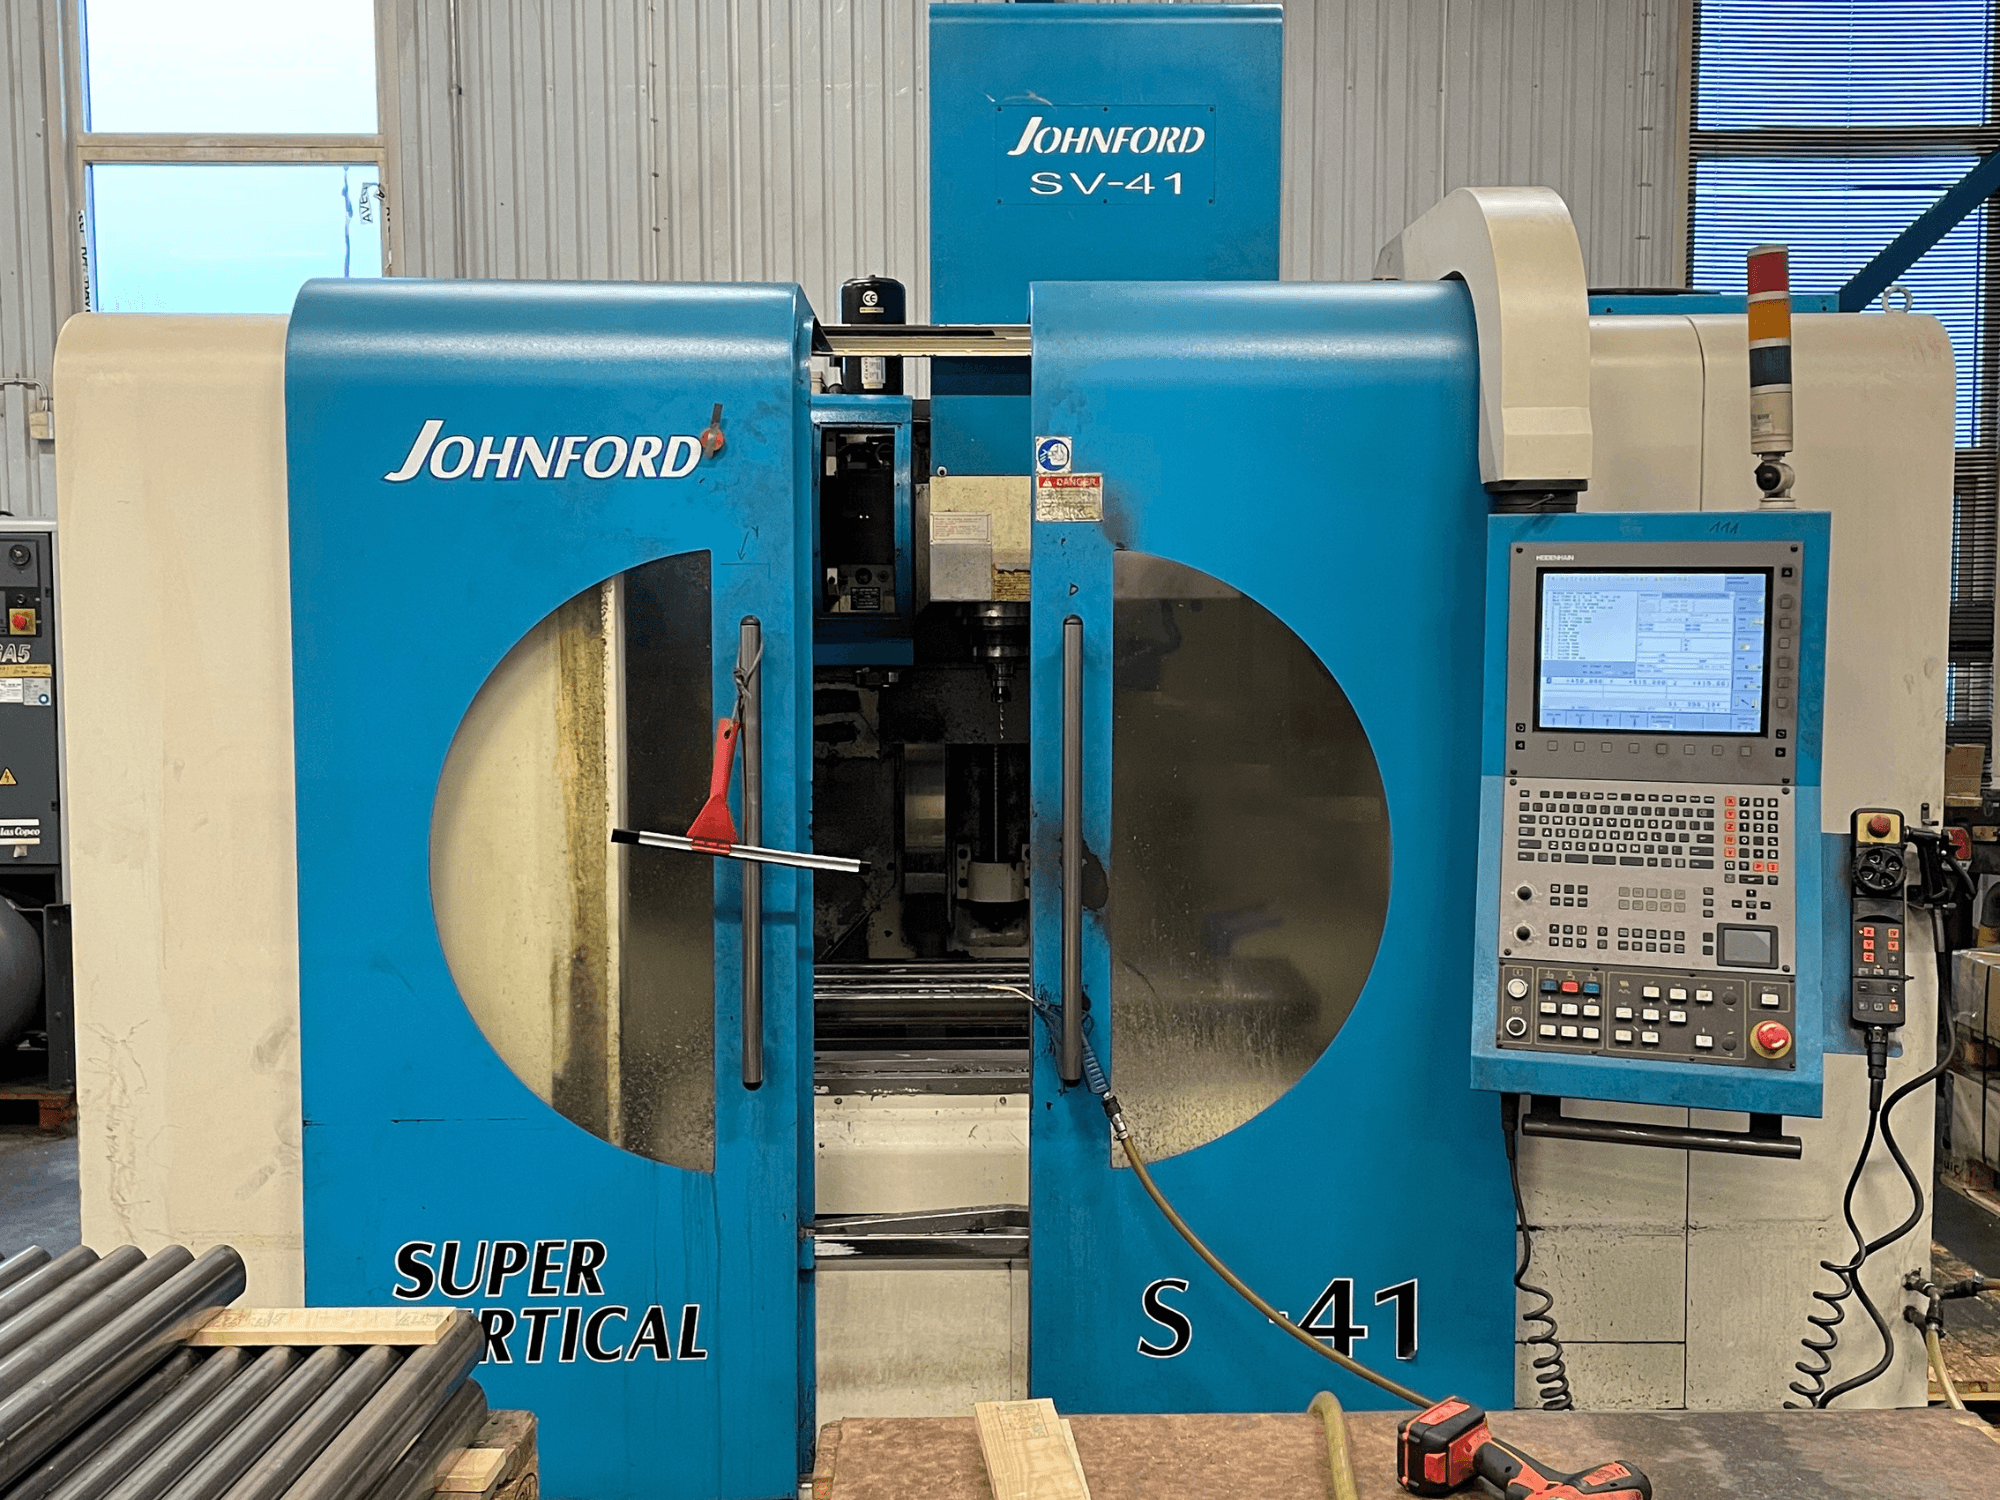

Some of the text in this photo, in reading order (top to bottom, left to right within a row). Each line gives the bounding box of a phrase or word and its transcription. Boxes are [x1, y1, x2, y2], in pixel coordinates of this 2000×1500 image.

[1007, 116, 1206, 156] JOHNFORD
[1030, 171, 1183, 195] SV-41
[383, 418, 703, 482] JOHNFORD
[1056, 477, 1099, 487] DANGER
[0, 643, 31, 664] A5
[0, 827, 40, 837] las Copco
[392, 1239, 607, 1300] SUPER
[457, 1303, 708, 1364] RTICAL
